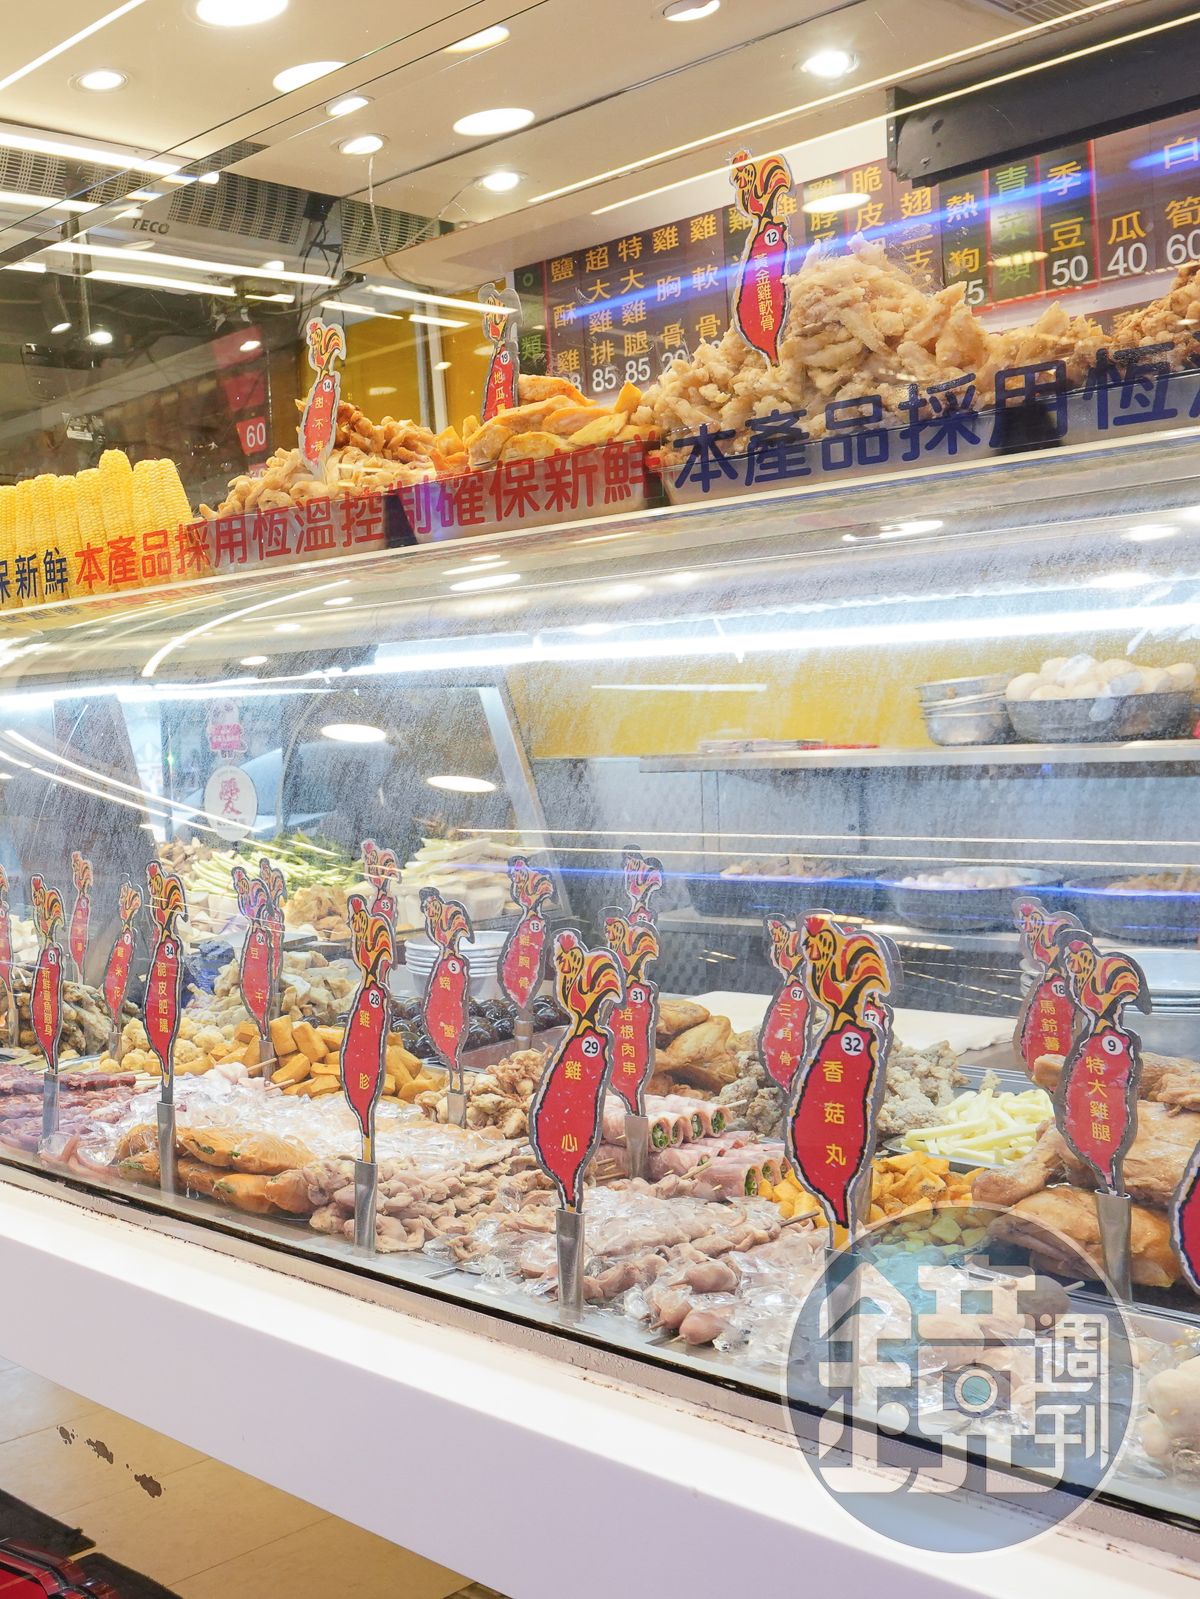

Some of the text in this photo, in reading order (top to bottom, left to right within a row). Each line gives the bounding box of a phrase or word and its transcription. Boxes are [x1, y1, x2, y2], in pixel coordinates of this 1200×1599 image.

[132, 217, 169, 234] TECO
[766, 232, 778, 244] 12
[945, 191, 981, 277] 熱狗
[1107, 243, 1148, 276] 40
[618, 235, 649, 357] 特大雞腿
[652, 226, 685, 349] 雞胸骨
[690, 214, 722, 338] 雞軟骨
[753, 253, 775, 332] 黃金雞軟骨
[1052, 255, 1089, 286] 50
[585, 246, 615, 366] 超大雞排
[592, 368, 617, 392] 85
[625, 357, 650, 384] 85
[246, 422, 266, 448] 60
[674, 330, 1200, 494] 本產品採用恆
[74, 436, 666, 596] 本產品採用恆溫控制確保新鮮
[632, 989, 644, 1001] 31
[584, 1040, 599, 1055] 29
[619, 1008, 637, 1076] 培根肉串
[844, 1037, 862, 1052] 32
[1107, 1039, 1117, 1052] 9
[562, 1059, 582, 1152] 雞心
[822, 1060, 847, 1167] 香菇丸
[1085, 1055, 1112, 1143] 特大雞腿
